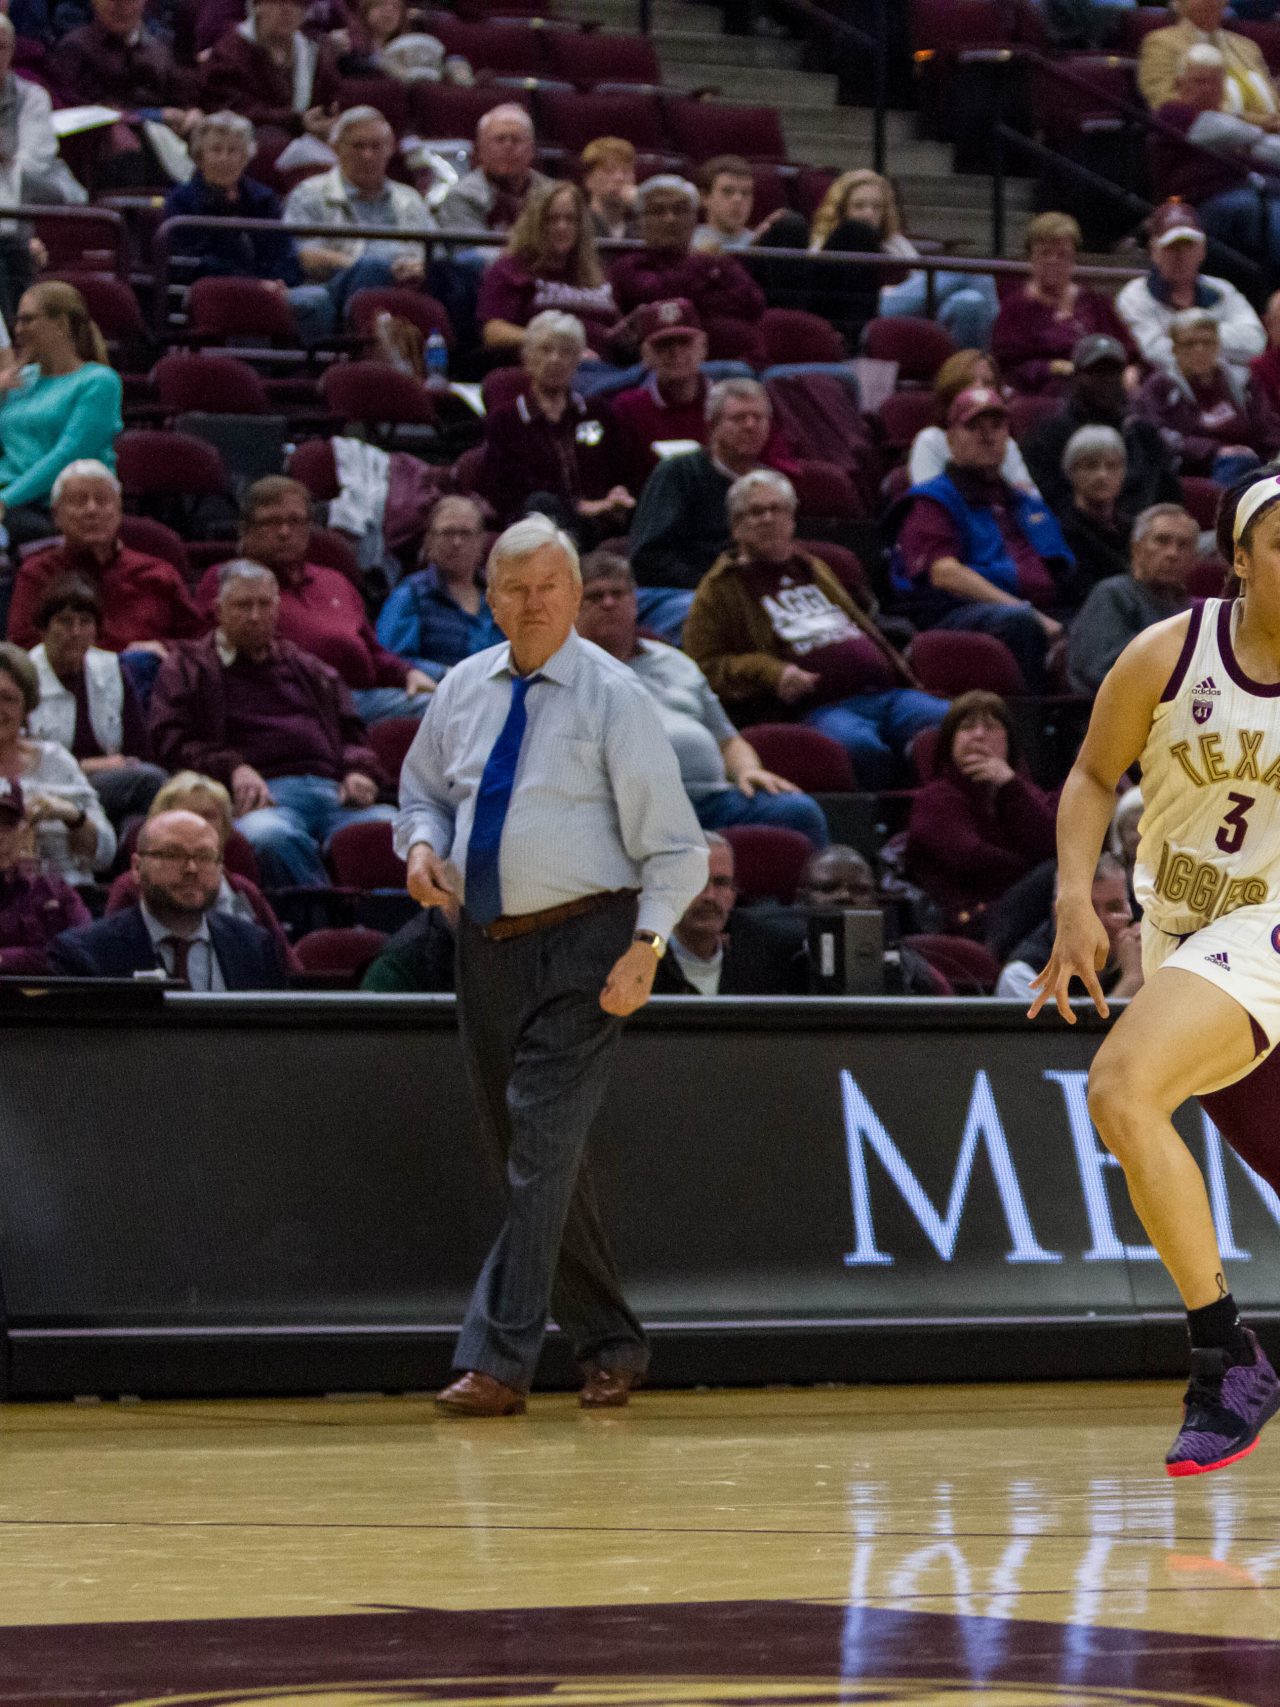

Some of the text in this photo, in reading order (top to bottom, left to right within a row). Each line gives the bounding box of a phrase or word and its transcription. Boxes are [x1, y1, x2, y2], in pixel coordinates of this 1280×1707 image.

[1191, 688, 1222, 696] adidas
[1194, 706, 1208, 718] 41
[1214, 791, 1256, 854] 3
[1204, 956, 1231, 972] adidas
